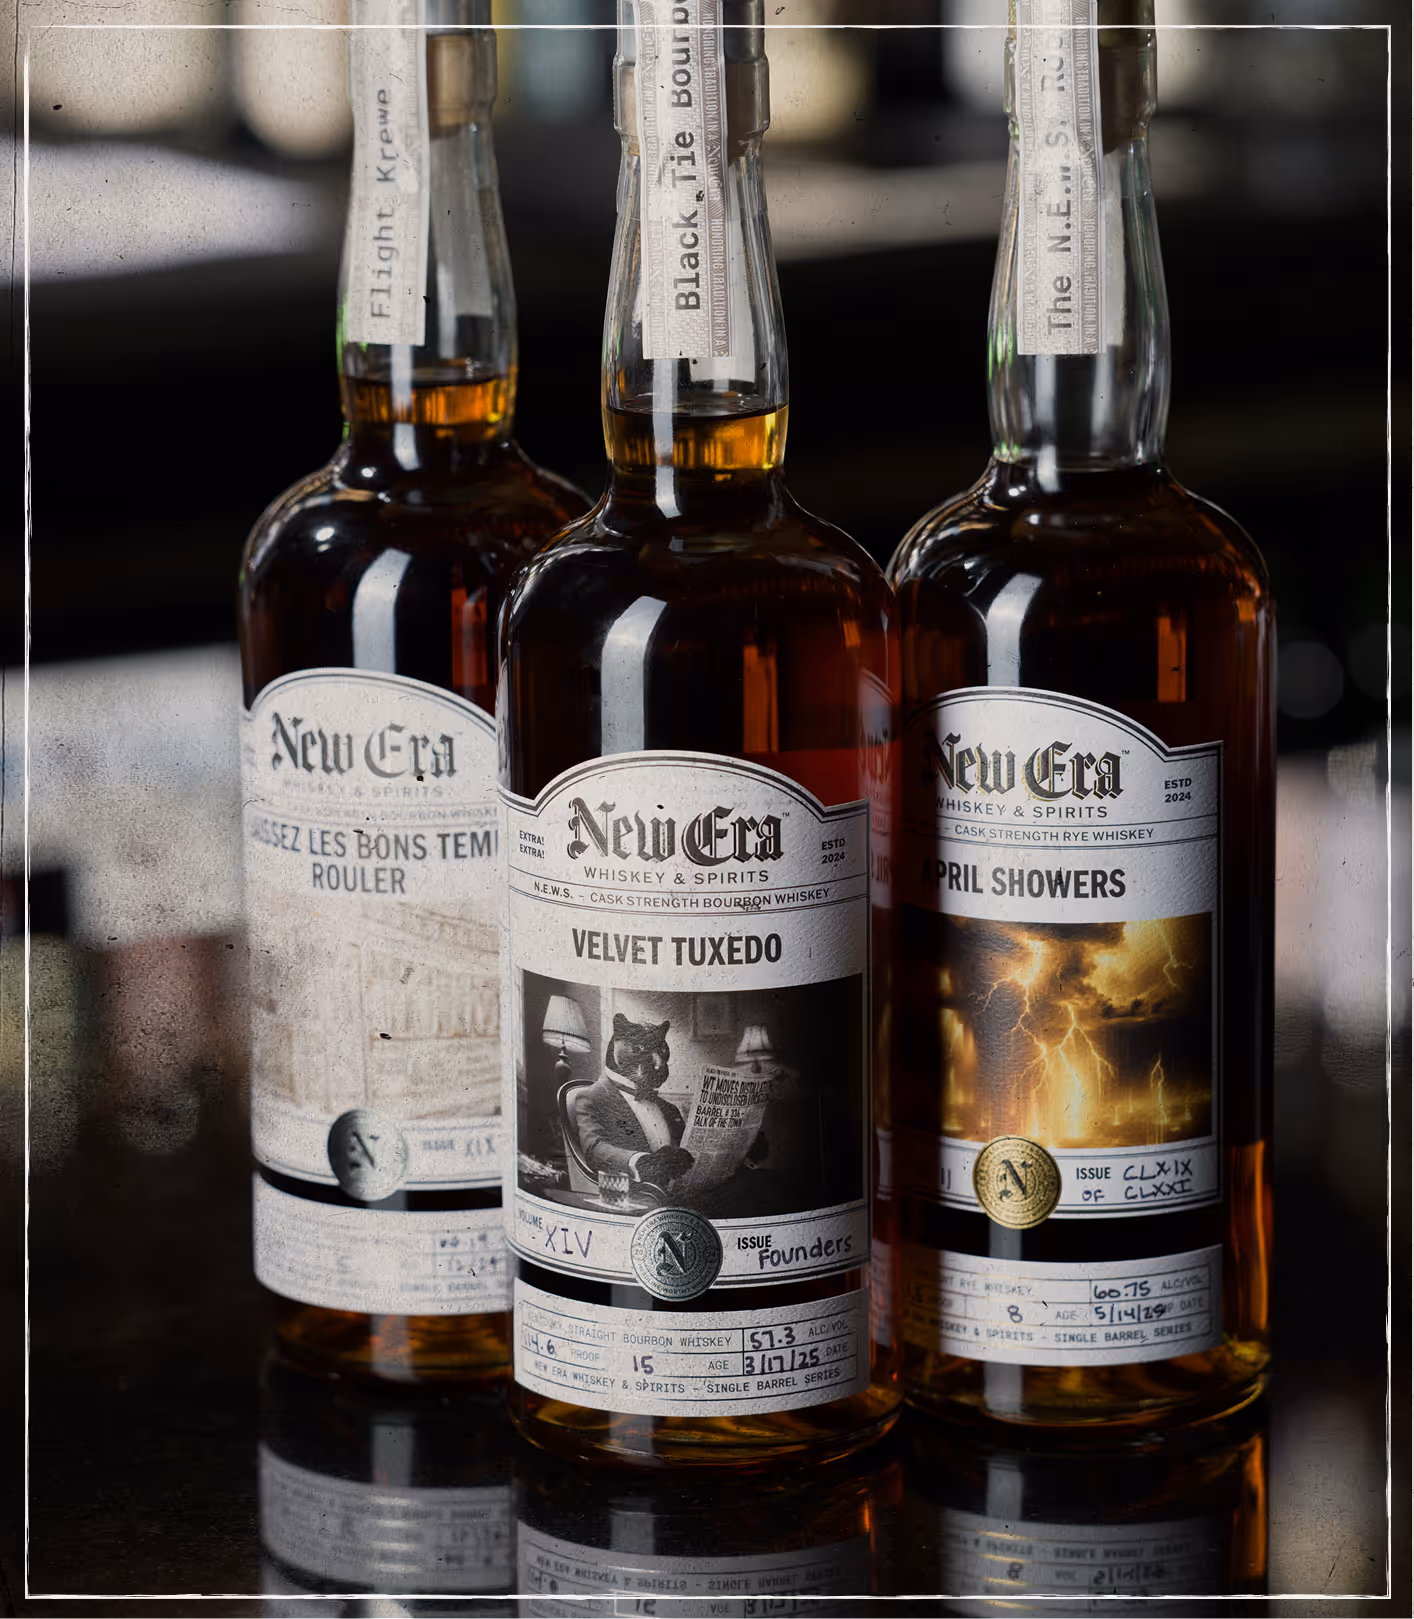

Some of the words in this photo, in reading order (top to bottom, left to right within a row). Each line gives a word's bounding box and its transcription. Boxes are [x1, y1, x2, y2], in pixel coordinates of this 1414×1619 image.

[375, 88, 398, 184] Krewe
[668, 130, 698, 189] Tie
[370, 205, 399, 319] Flight
[671, 209, 701, 311] Black
[1047, 274, 1073, 337] The
[271, 711, 354, 776] New
[363, 722, 457, 779] Era
[1163, 777, 1193, 791] ESTD
[1164, 790, 1193, 804] 2024
[1012, 805, 1026, 818] &
[1032, 805, 1109, 819] SPIRITS
[519, 829, 545, 846] EXTRA!
[566, 796, 677, 863] New
[954, 824, 987, 838] CASK
[989, 828, 1060, 842] STRENGTH
[1062, 830, 1090, 842] RYE
[1092, 828, 1155, 842] WHISKEY
[308, 827, 347, 858] LES
[356, 833, 428, 861] BONS
[436, 829, 499, 859] TEM
[519, 843, 545, 859] EXTRA!
[821, 837, 846, 851] ESTD
[821, 851, 846, 865] 2024
[311, 861, 406, 895] ROULER
[583, 865, 667, 884] WHISKEY
[673, 872, 686, 885] &
[693, 869, 770, 885] SPIRITS
[990, 866, 1127, 899] SHOWERS
[533, 880, 574, 899] N.E.W.S.
[589, 891, 625, 905] CASK
[626, 894, 699, 908] STRENGTH
[702, 894, 772, 909] BOURBON
[773, 887, 830, 905] WHISKEY
[571, 927, 664, 965] VELVET
[670, 932, 783, 967] TUXEDO
[699, 1090, 709, 1104] TO
[693, 1116, 708, 1128] TALK
[708, 1117, 717, 1128] OF
[695, 1106, 723, 1118] BARREL
[1076, 1167, 1112, 1180] ISSUE
[518, 1207, 543, 1230] VOLUME
[544, 1224, 593, 1259] XIV
[737, 1234, 772, 1250] ISSUE
[758, 1235, 853, 1270] Founders
[1093, 1280, 1151, 1300] 60.75
[1007, 1304, 1024, 1324] 8
[1056, 1309, 1077, 1321] AGE
[567, 1323, 617, 1341] STRAIGHT
[623, 1333, 673, 1347] BOURBON
[679, 1336, 732, 1348] WHISKEY
[749, 1326, 796, 1350] 57.3
[807, 1319, 849, 1337] ALC/VOL
[1054, 1330, 1098, 1343] SINGLE
[1104, 1329, 1147, 1343] BARREL
[570, 1349, 601, 1362] PROOF
[633, 1355, 655, 1375] 15
[707, 1360, 730, 1370] AGE
[745, 1347, 820, 1376] 3/17/25
[534, 1360, 548, 1372] NEW
[551, 1366, 568, 1379] ERA
[572, 1371, 616, 1388] WHISKEY
[621, 1379, 630, 1390] &
[635, 1380, 686, 1394] SPIRITS
[706, 1381, 751, 1394] SINGLE
[756, 1376, 798, 1391] BARREL
[803, 1367, 841, 1384] SERIES
